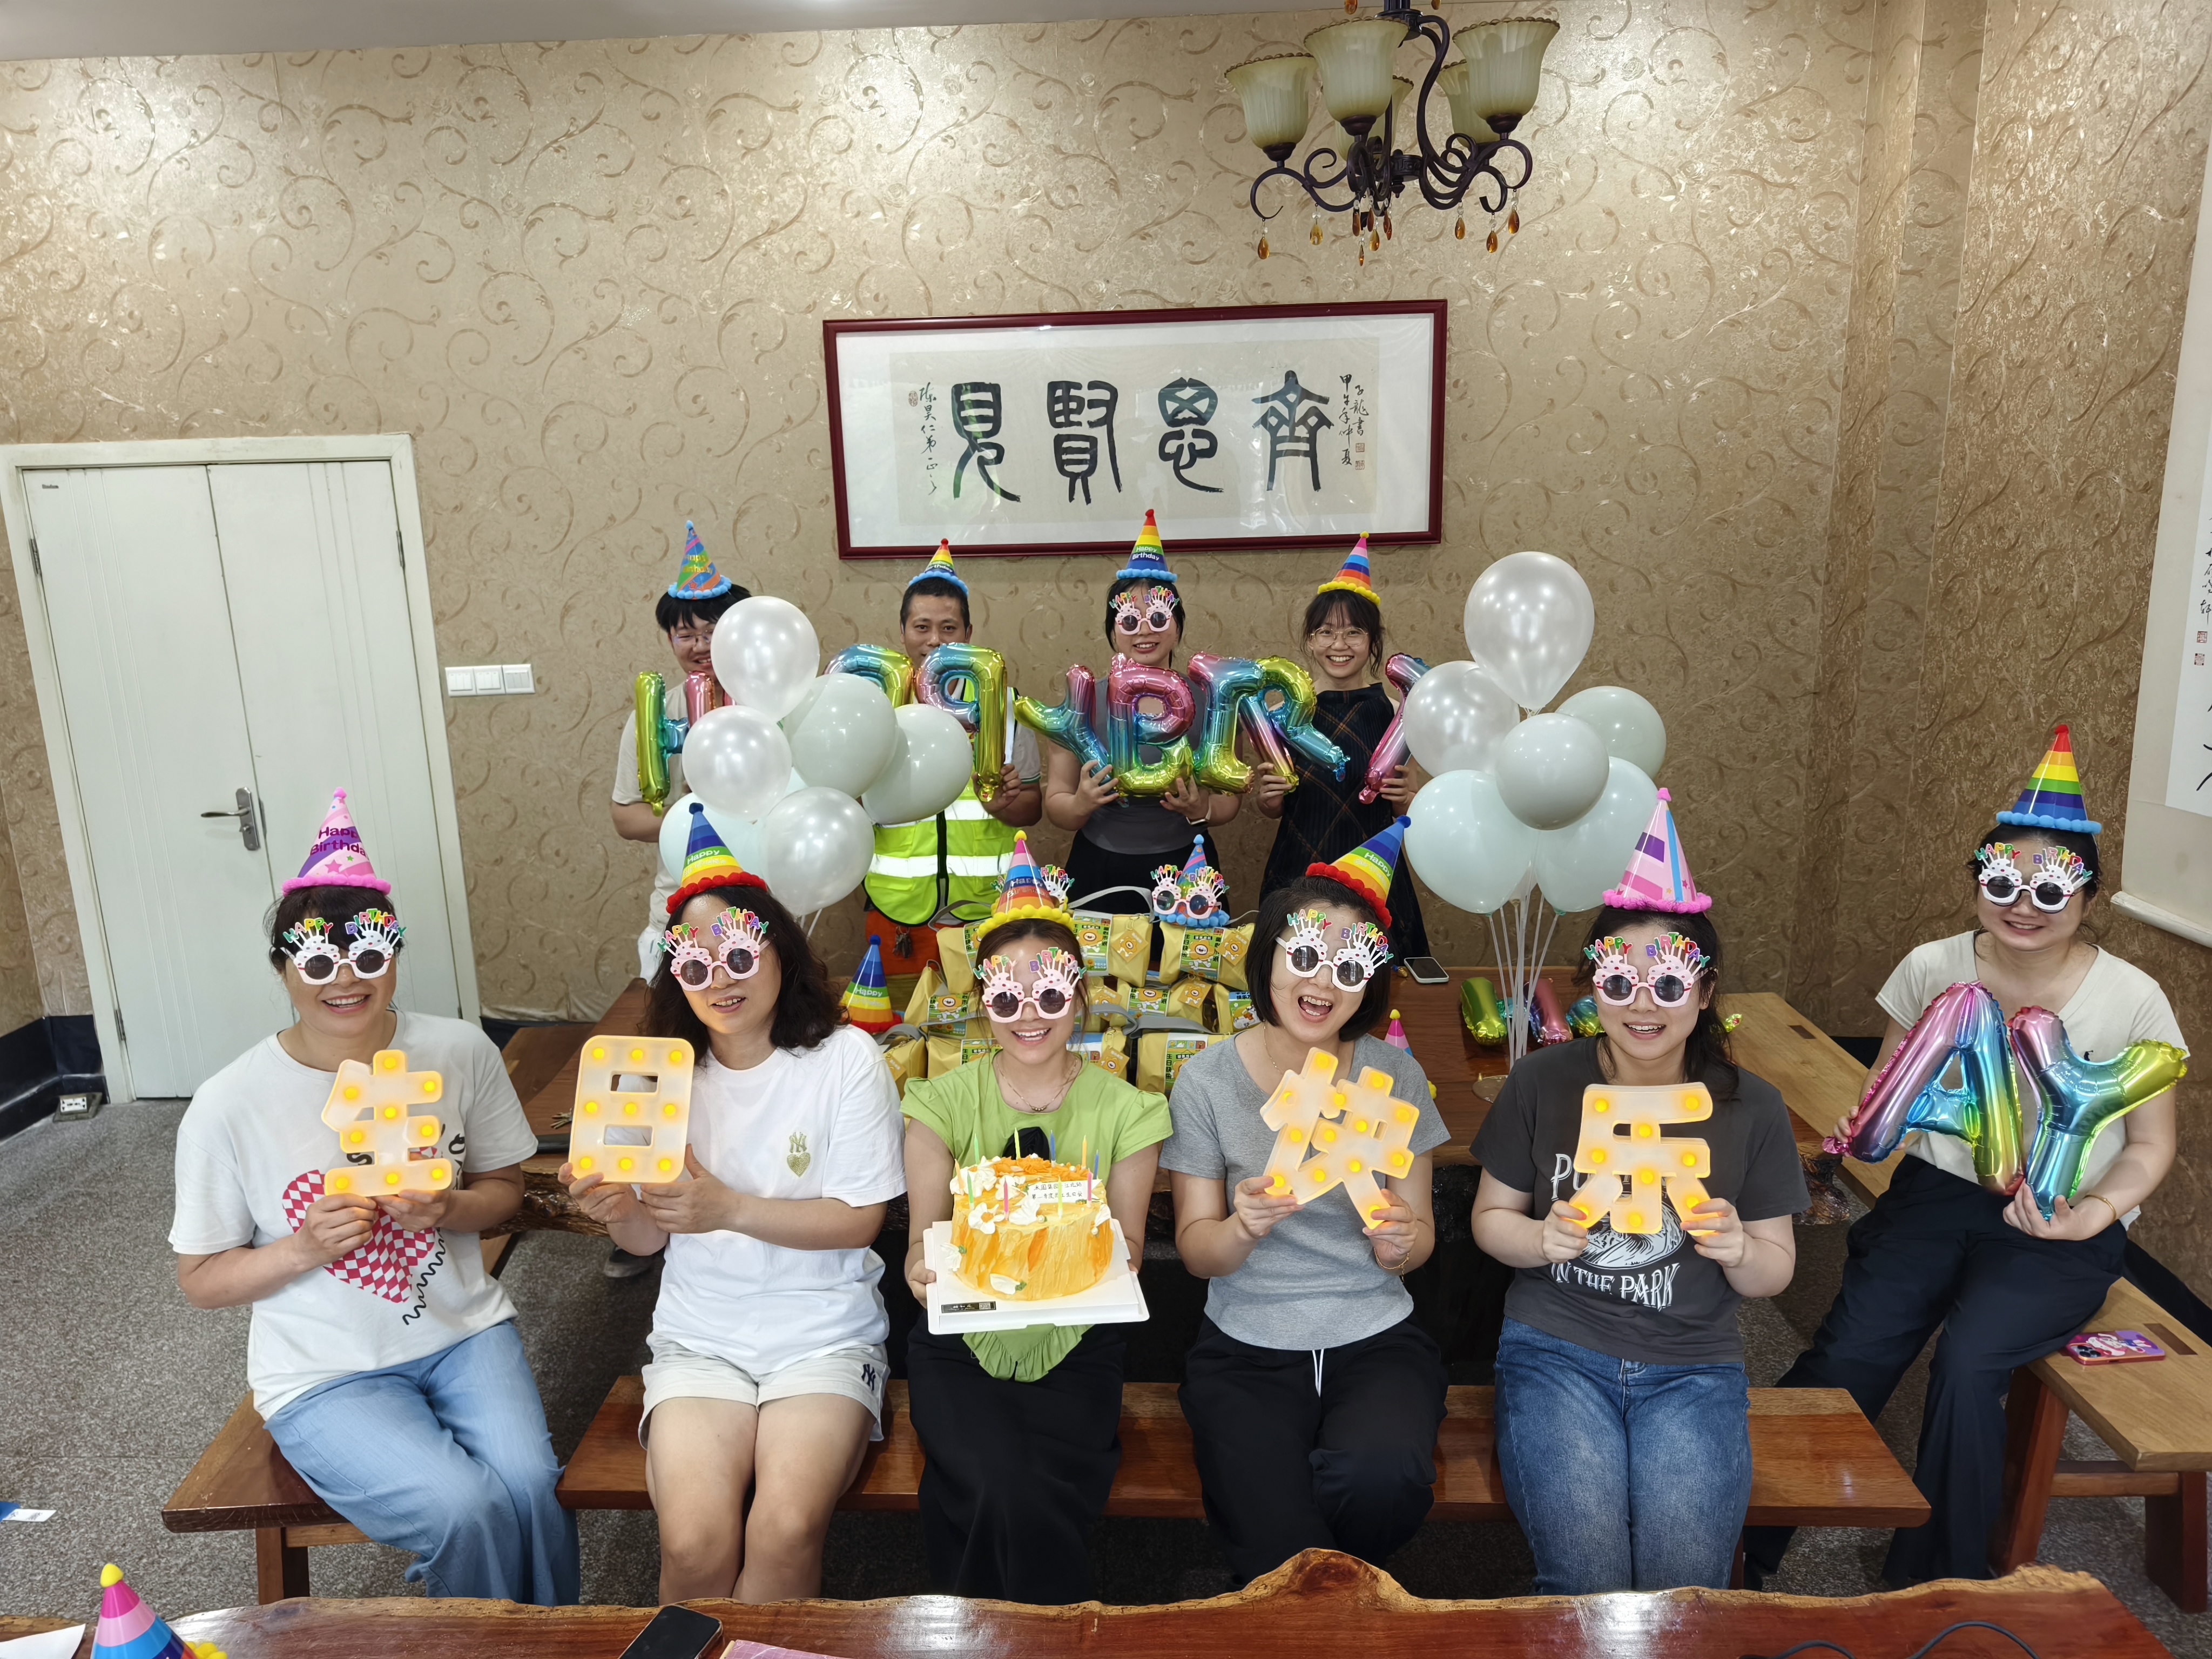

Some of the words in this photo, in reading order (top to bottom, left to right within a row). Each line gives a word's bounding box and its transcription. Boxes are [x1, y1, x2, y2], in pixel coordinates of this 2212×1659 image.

[1132, 552, 1159, 561] Birthday
[1109, 592, 1137, 609] HAPPY
[1143, 585, 1180, 606] BIRTHDAY
[318, 826, 359, 839] Happ
[309, 839, 369, 860] Birthda
[687, 850, 720, 865] Happy
[1365, 852, 1391, 877] Happy
[1974, 842, 2021, 860] HAPPY
[2033, 846, 2093, 880] BIRTHDAY
[1040, 865, 1075, 887] RTHDAY
[1150, 864, 1183, 879] HAPPY
[1189, 866, 1230, 893] BIRTHDAY
[282, 917, 333, 943] HAPPY
[345, 908, 407, 938] BIRTHDAY
[657, 922, 699, 952] HAPPY
[711, 906, 769, 936] BIRTHDAY
[1287, 909, 1332, 930] HAPPY
[1340, 922, 1394, 963] BIRTHDAY
[1182, 934, 1191, 957] 生日快乐
[1583, 936, 1633, 960] HAPPY
[1645, 932, 1710, 968] BIRTHDAY
[973, 954, 1017, 979] HAPPY
[1029, 947, 1087, 979] BIRTHDAY
[855, 987, 882, 997] Happy
[569, 1035, 694, 1183] 日
[1847, 980, 2188, 1221] AY
[321, 1049, 452, 1197] 生
[1260, 1047, 1419, 1230] 快
[1562, 1082, 1718, 1236] 乐
[1573, 1265, 1615, 1294] THE
[1620, 1263, 1680, 1312] PARK
